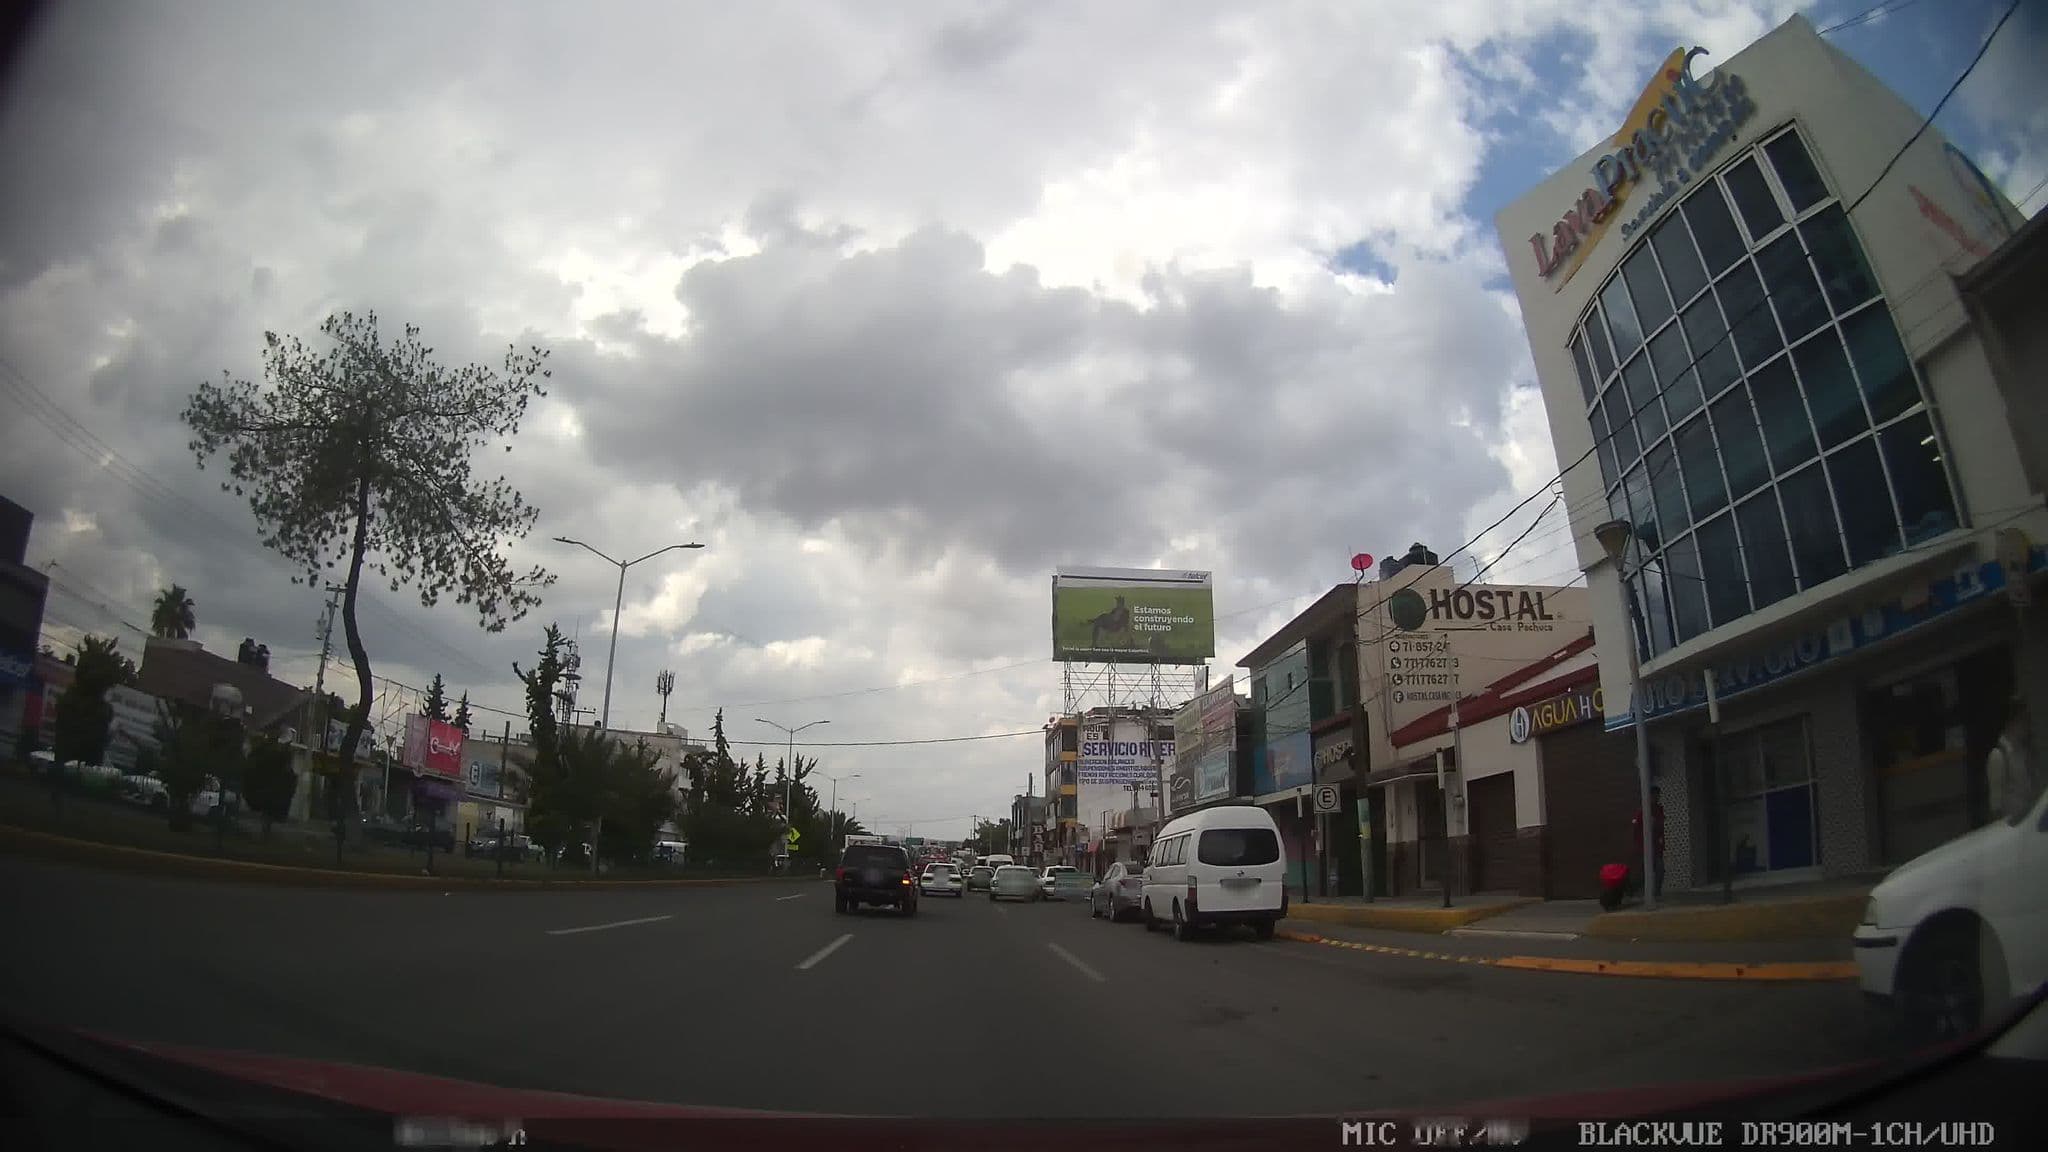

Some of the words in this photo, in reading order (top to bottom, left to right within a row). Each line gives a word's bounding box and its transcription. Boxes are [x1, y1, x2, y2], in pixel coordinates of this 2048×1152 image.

[1134, 606, 1172, 614] Estamos
[1430, 589, 1553, 621] HOSTAL
[1134, 616, 1194, 624] construyendo
[1134, 623, 1143, 631] el
[1144, 623, 1172, 631] futuro
[1490, 622, 1512, 631] Casa
[1518, 621, 1553, 632] Pachuca
[1404, 658, 1459, 668] 771776273
[1405, 674, 1459, 685] 771776277
[1532, 698, 1577, 732] AGUA
[1087, 732, 1099, 740] ES
[1083, 742, 1138, 756] SERVICIO
[1323, 791, 1332, 803] E
